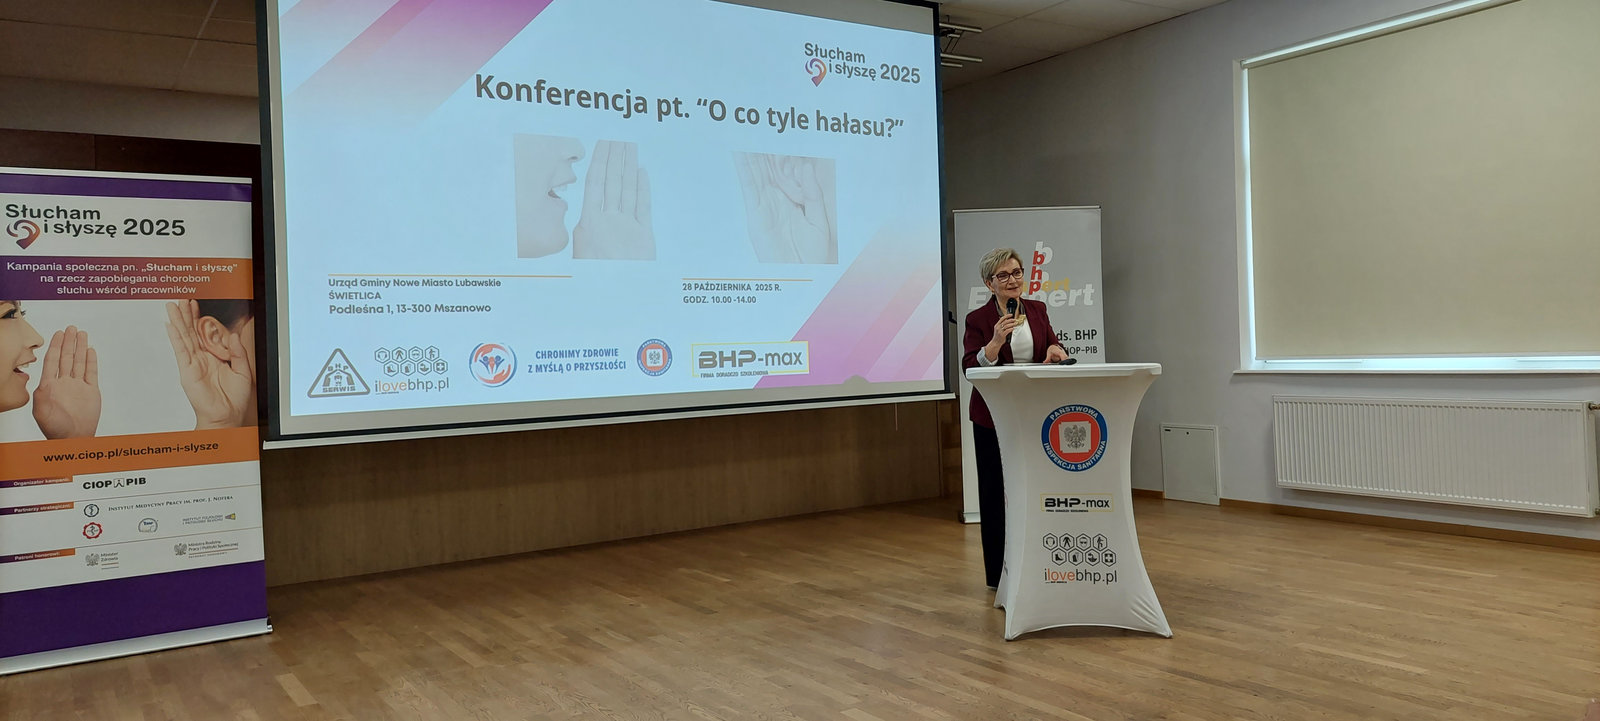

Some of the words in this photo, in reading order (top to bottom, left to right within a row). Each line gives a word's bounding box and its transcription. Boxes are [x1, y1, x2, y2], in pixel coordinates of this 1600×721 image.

[804, 42, 866, 63] Słucham
[828, 60, 833, 73] i
[835, 62, 877, 81] słyszę
[880, 63, 921, 84] 2025
[475, 73, 648, 119] Konferencja
[656, 97, 690, 122] pt.
[734, 104, 760, 125] co
[766, 106, 809, 133] tyle
[5, 203, 101, 220] Słucham
[43, 219, 49, 234] i
[53, 220, 118, 238] słyszę
[123, 218, 186, 236] 2025
[6, 261, 63, 273] Kampania
[65, 262, 119, 273] społeczna
[122, 264, 138, 273] pn.
[141, 262, 193, 273] „Słucham
[40, 275, 54, 283] na
[57, 275, 85, 283] rzecz
[88, 274, 157, 284] zapobiegania
[160, 274, 211, 283] chorobom
[328, 278, 358, 289] Urząd
[360, 278, 391, 289] Gminy
[393, 278, 420, 287] Nowe
[421, 278, 454, 287] Miasto
[455, 278, 501, 287] Lubawskie
[56, 285, 93, 295] słuchu
[95, 284, 127, 295] wśród
[130, 285, 197, 295] pracowników
[682, 283, 693, 291] 28
[693, 280, 752, 292] PAŹDZIERNIKA
[755, 283, 773, 292] 2025
[774, 283, 782, 292] R.
[328, 291, 382, 300] ŚWIETLICA
[683, 295, 709, 304] GODZ.
[711, 295, 732, 304] 10.00
[329, 303, 384, 314] Podleśna
[387, 304, 394, 315] 1,
[396, 303, 432, 313] 13-300
[434, 303, 492, 313] Mszanowo
[1074, 329, 1097, 341] BHP
[535, 349, 581, 359] CHRONIMY
[582, 347, 618, 357] ZDROWIE
[698, 349, 803, 369] BHP-max
[528, 364, 533, 373] Z
[535, 362, 564, 374] MYŚLĄ
[565, 363, 572, 372] O
[574, 359, 627, 371] PRZYSZŁOŚCI
[322, 385, 356, 393] SERWIS
[374, 377, 450, 392] ilovebhp.pl
[43, 442, 219, 462] www.ciop.pl/slucham-i-slysze
[1043, 442, 1076, 471] INSPEKCJA
[1077, 440, 1106, 470] SANITARNA
[82, 479, 113, 490] CIOP
[125, 477, 147, 486] PIB
[1044, 498, 1110, 508] BHP-max
[1044, 568, 1118, 585] ilovebhp.pl
